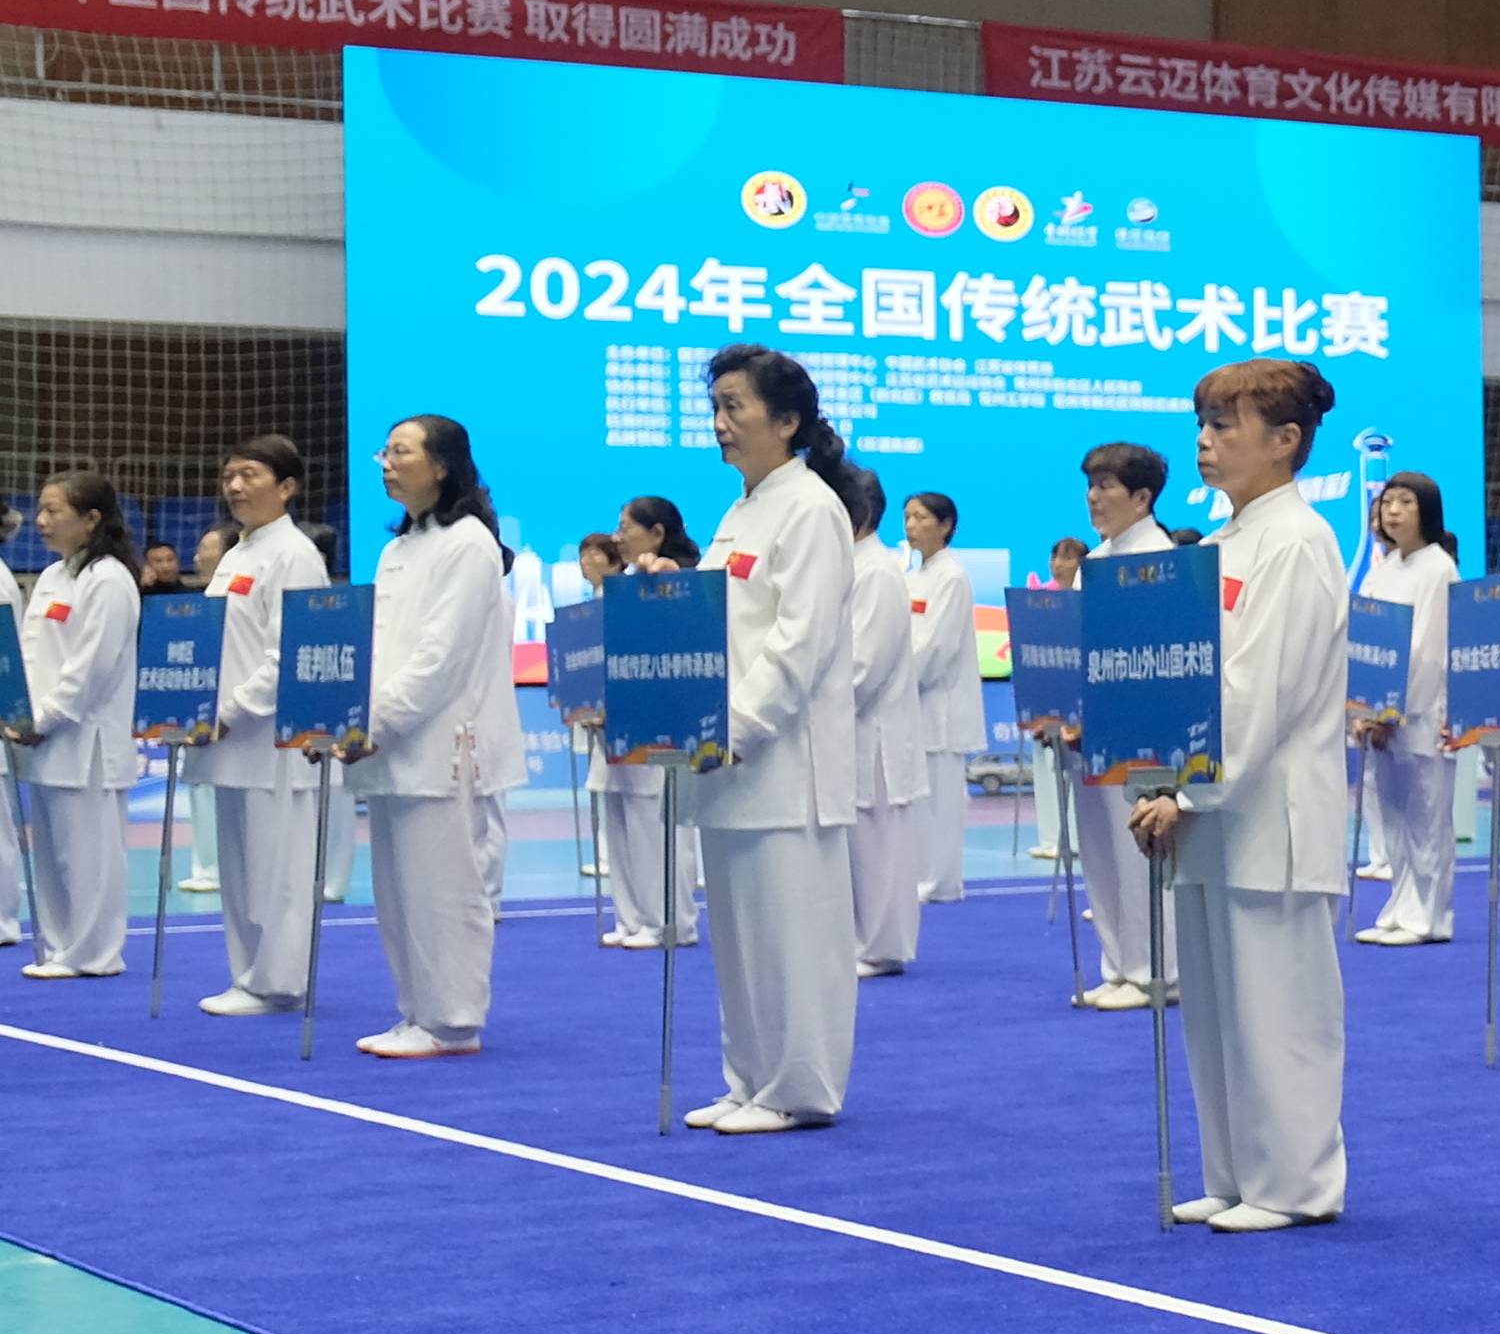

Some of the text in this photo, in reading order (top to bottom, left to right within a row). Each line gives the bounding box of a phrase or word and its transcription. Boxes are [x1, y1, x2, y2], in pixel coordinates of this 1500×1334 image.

[473, 253, 1390, 359] 2024年全国传统武术比赛
[296, 643, 356, 683] 裁判队伍
[1087, 639, 1215, 684] 泉州市山外山国术馆
